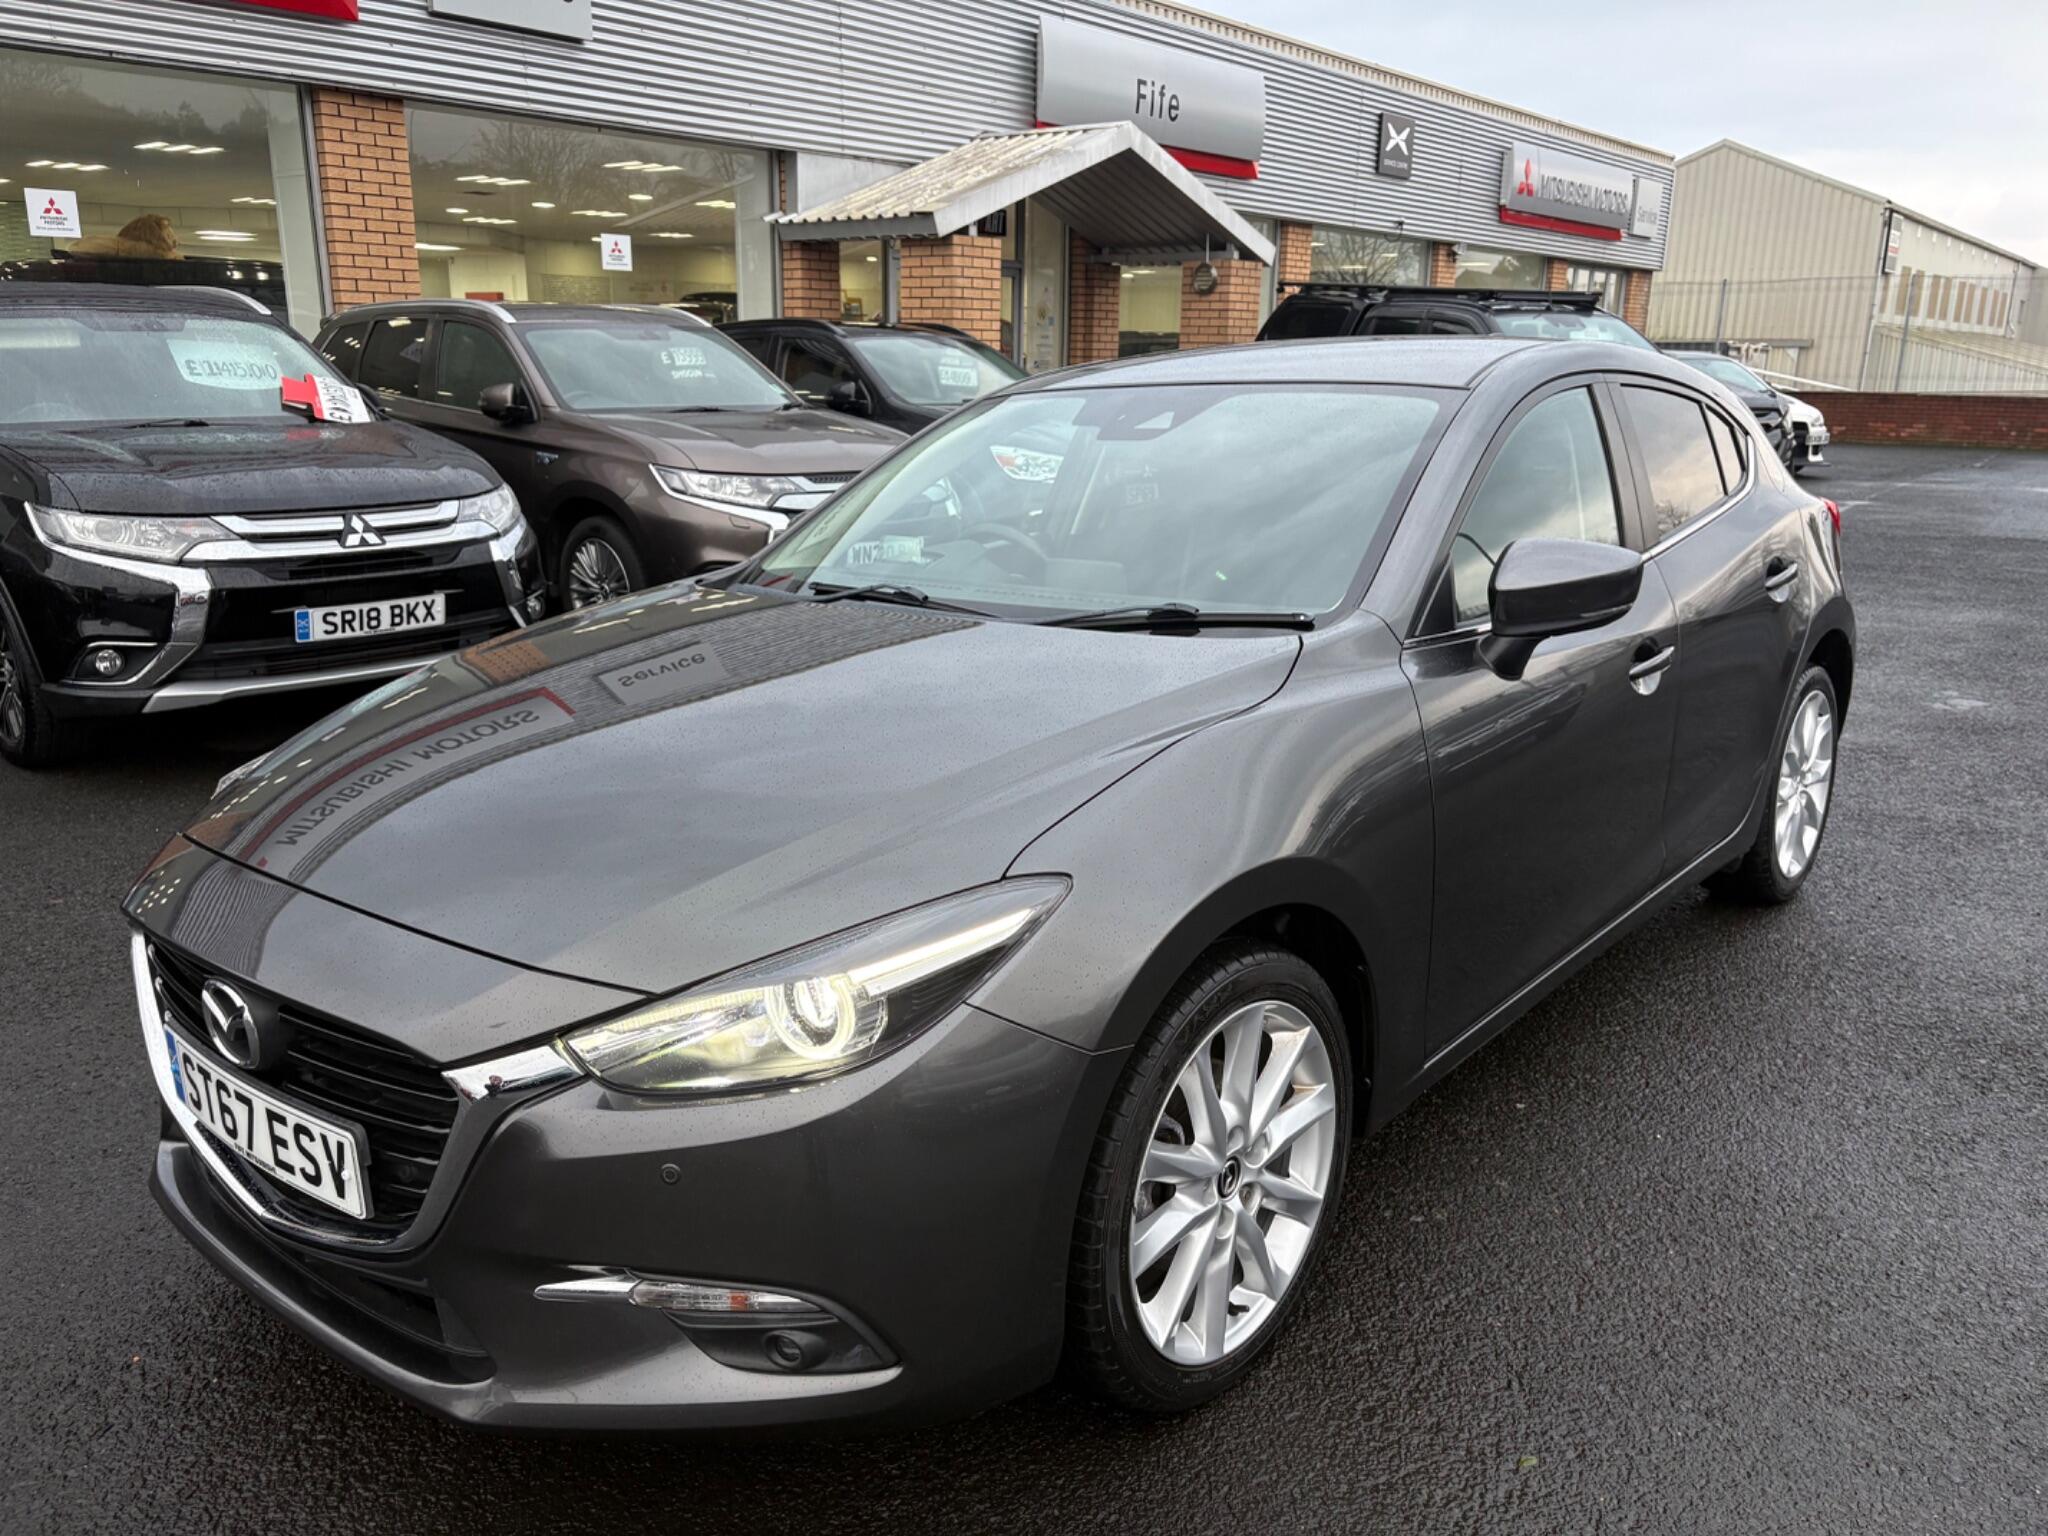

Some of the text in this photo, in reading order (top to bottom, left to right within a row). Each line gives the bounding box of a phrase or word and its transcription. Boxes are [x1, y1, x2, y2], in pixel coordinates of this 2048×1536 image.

[1135, 78, 1180, 122] Fife
[1538, 174, 1630, 215] MITSUBISHI MOTORS
[1636, 206, 1658, 225] Service
[321, 607, 381, 635] SR18
[389, 599, 436, 628] BKX
[181, 1051, 254, 1152] ST67
